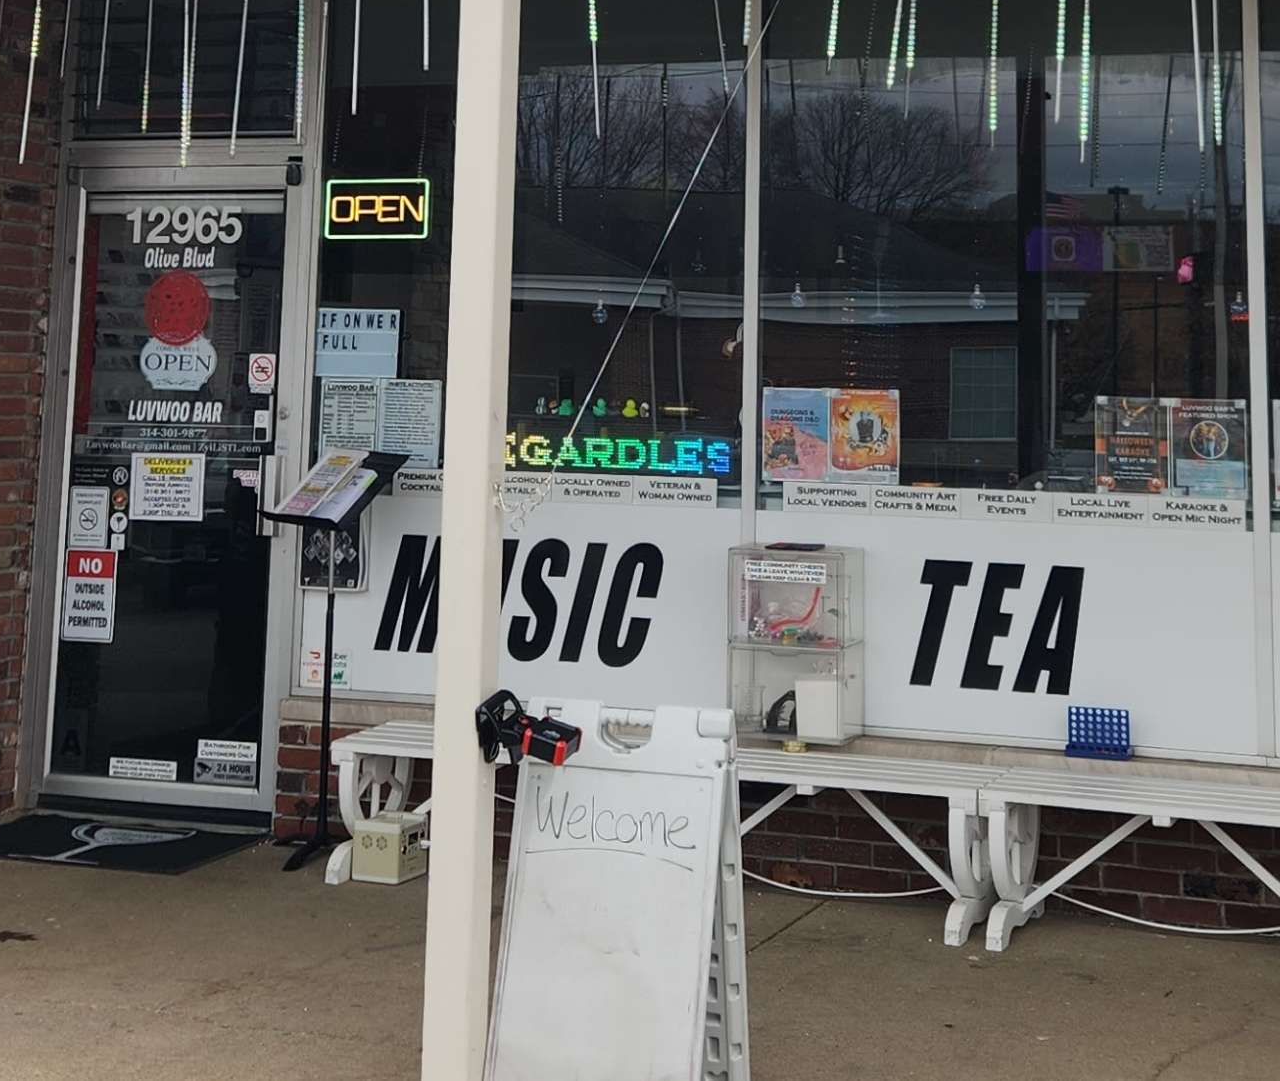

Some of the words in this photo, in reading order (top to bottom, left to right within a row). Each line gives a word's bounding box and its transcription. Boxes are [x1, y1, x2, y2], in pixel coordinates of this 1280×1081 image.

[331, 195, 424, 222] OPEN
[126, 206, 243, 244] 12965
[144, 247, 179, 268] Olive
[182, 246, 215, 268] Blvd
[321, 313, 337, 328] IF
[390, 314, 397, 329] R
[322, 335, 358, 350] FULL
[144, 352, 212, 372] OPEN
[128, 400, 190, 423] LUVWOO
[192, 401, 223, 423] BAR
[139, 427, 208, 439] 314-301-9877
[397, 472, 437, 481] PREMIUM
[554, 476, 595, 487] LOCALLY
[596, 479, 631, 489] OWNED
[650, 480, 692, 490] VETERAN
[797, 486, 858, 497] SUPPORTING
[572, 489, 621, 499] OPERATED
[638, 491, 674, 502] WOMAN
[676, 493, 713, 503] OWNED
[875, 488, 933, 500] COMMUNITY
[935, 491, 956, 501] ART
[977, 493, 1004, 503] FREE
[1006, 495, 1036, 504] DAILY
[787, 497, 820, 507] LOCAL
[821, 499, 867, 508] VENDORS
[874, 500, 912, 510] CRAFTS
[924, 503, 958, 512] MEDIA
[1071, 497, 1105, 507] LOCAL
[1106, 499, 1130, 509] LIVE
[1165, 501, 1217, 512] KARAOKE
[987, 505, 1026, 515] EVENTS
[1057, 509, 1144, 520] ENTERTAINMENT
[1152, 512, 1182, 523] OPEN
[1185, 514, 1206, 524] MIC
[1208, 515, 1242, 525] NIGHT
[79, 557, 103, 574] NO
[75, 582, 105, 595] OUTSIDE
[72, 599, 106, 612] ALCOHOL
[372, 533, 665, 668] MSIC
[68, 615, 108, 629] PERMITTED
[909, 558, 1086, 696] TEA
[216, 764, 227, 772] 24
[228, 765, 251, 774] HOUR
[537, 785, 696, 850] Welcome
